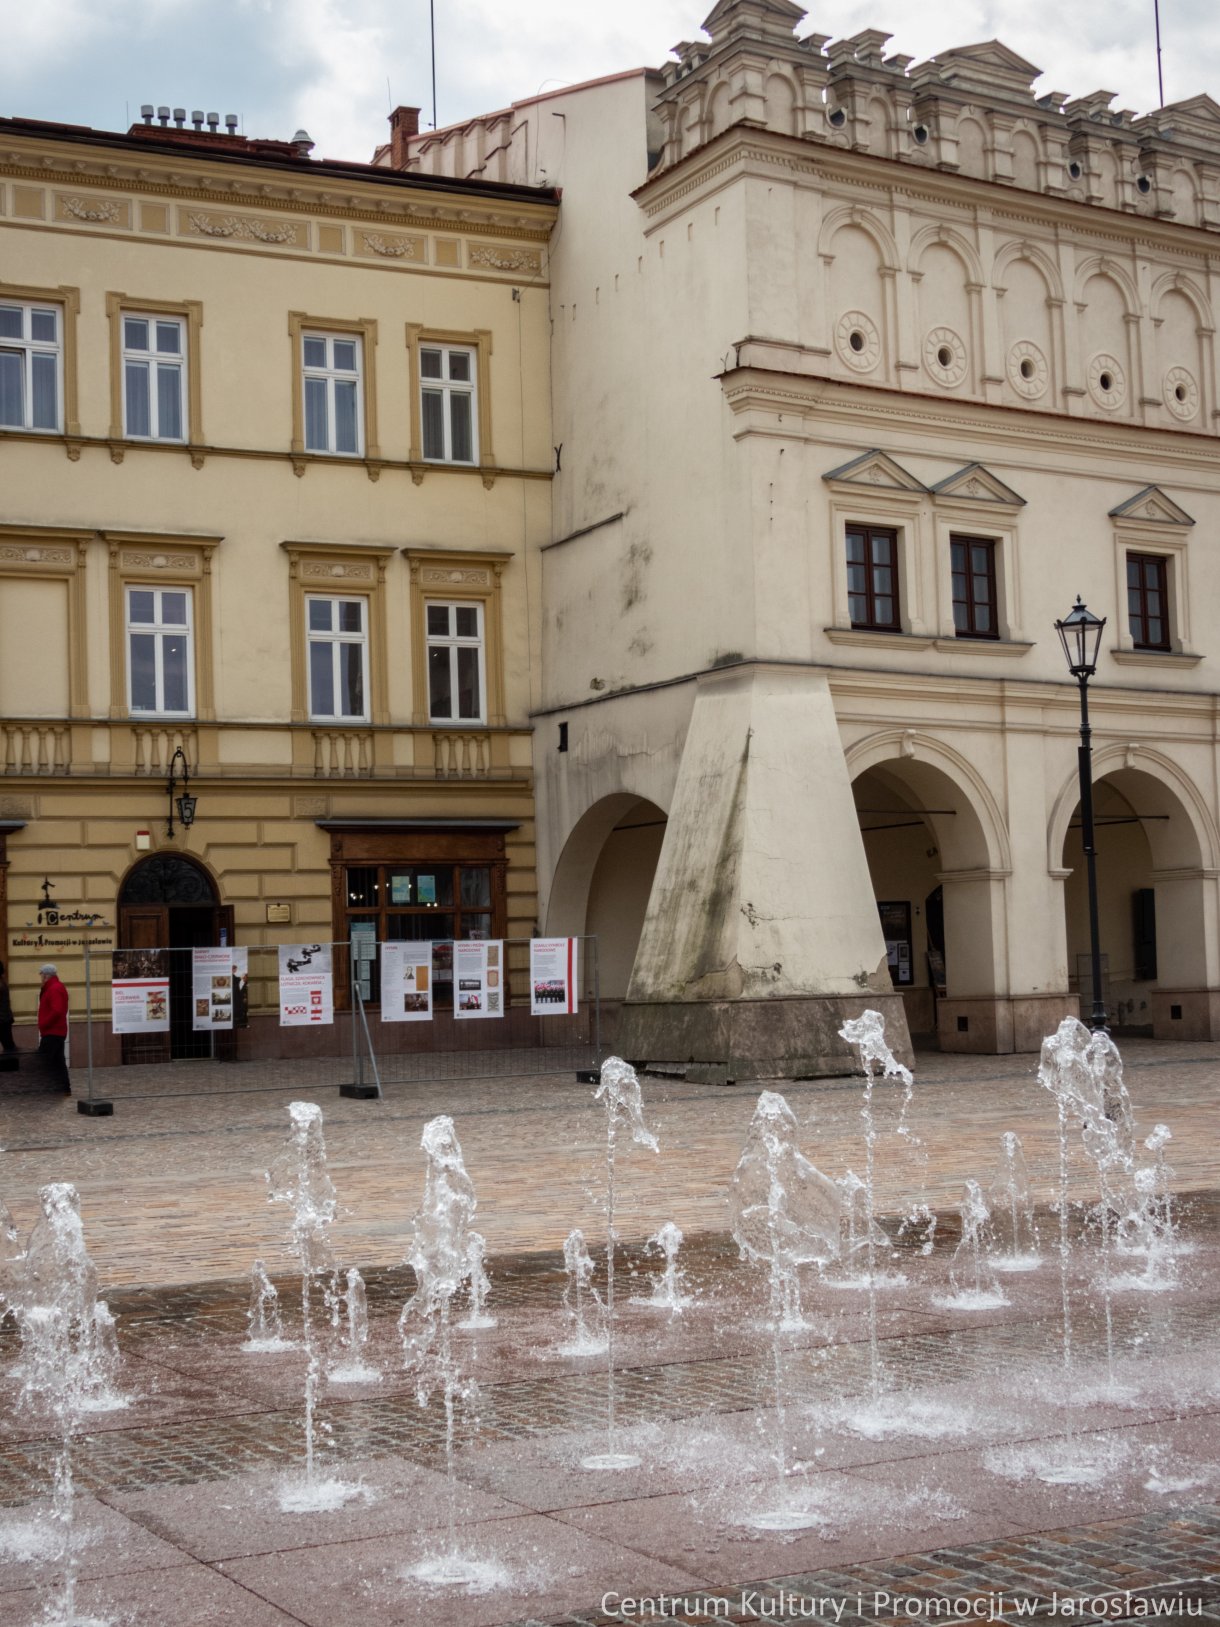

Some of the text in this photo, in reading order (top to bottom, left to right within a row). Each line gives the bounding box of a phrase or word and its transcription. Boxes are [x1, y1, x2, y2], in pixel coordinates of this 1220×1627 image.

[184, 802, 193, 819] 5
[46, 909, 104, 926] Centrum
[44, 938, 71, 946] Promocji
